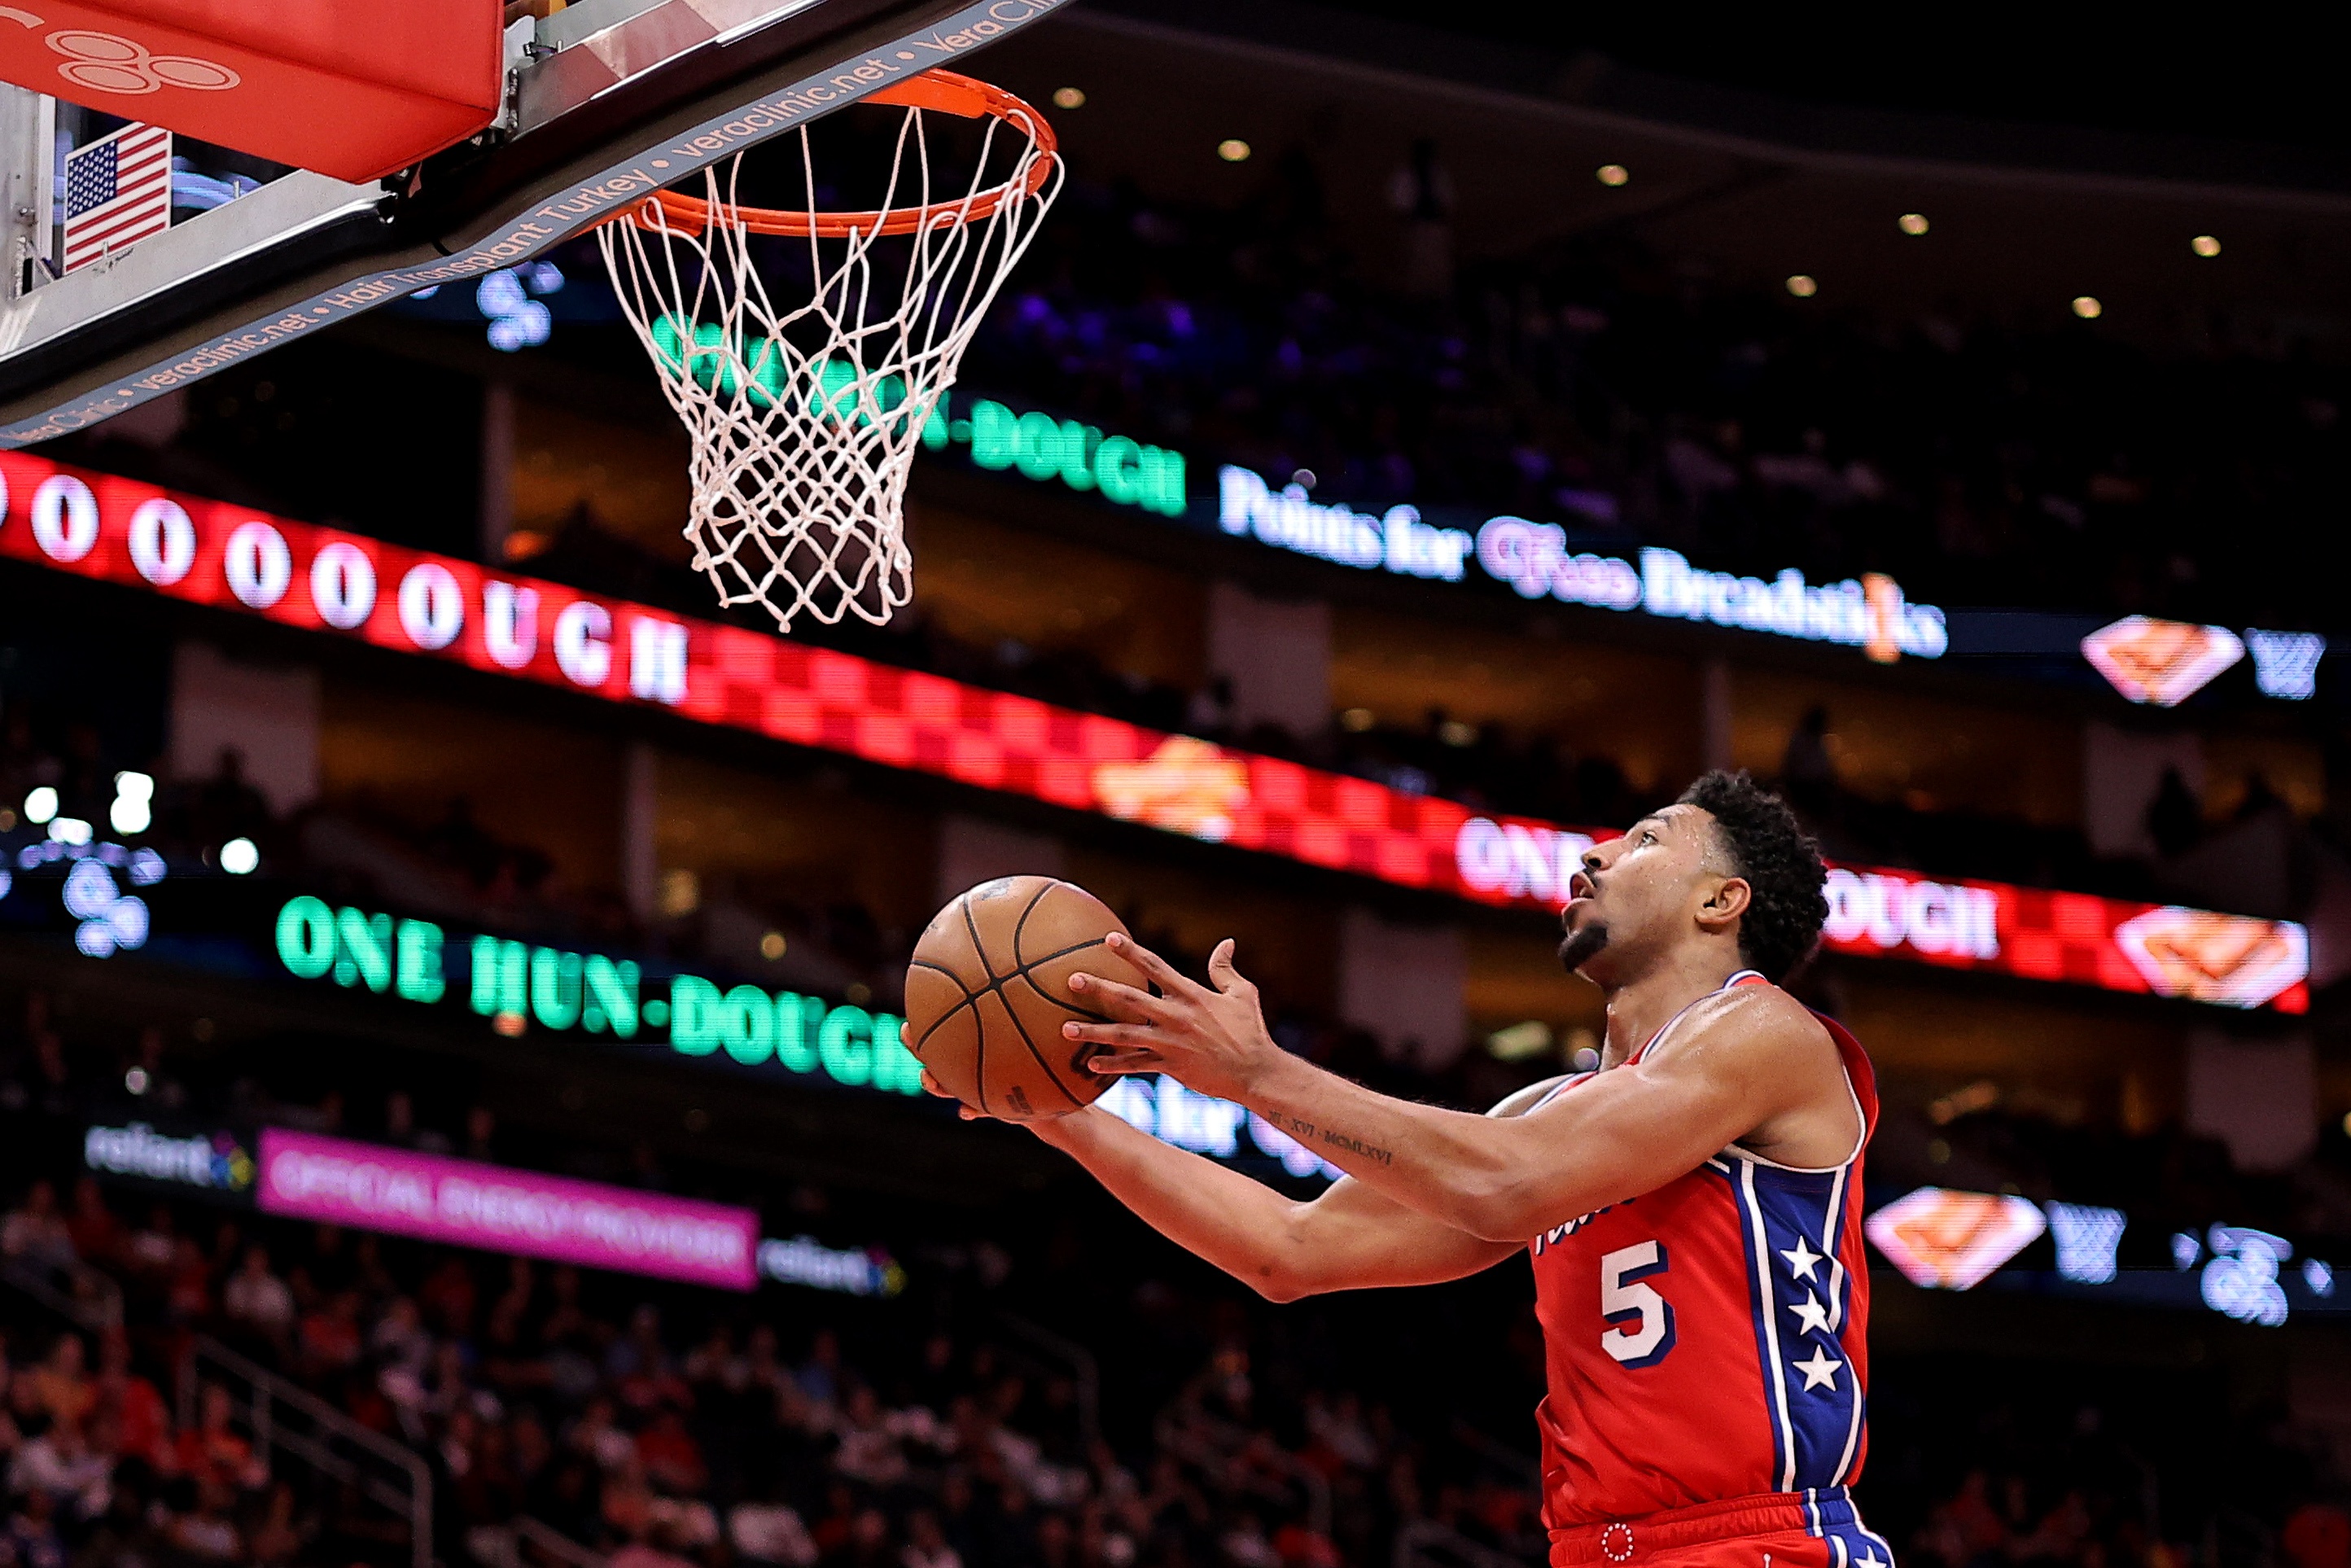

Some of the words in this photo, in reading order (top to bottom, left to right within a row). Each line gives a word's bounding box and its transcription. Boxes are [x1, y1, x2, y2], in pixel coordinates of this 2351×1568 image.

[133, 310, 320, 391] veraclinic.net
[326, 276, 396, 310] Hair
[387, 220, 555, 287] Transplant
[535, 166, 659, 221] Turkey
[672, 57, 892, 159] veraclinic.net
[913, 19, 1007, 54] Vera
[275, 895, 448, 1005] ONE
[1601, 1239, 1678, 1369] 5
